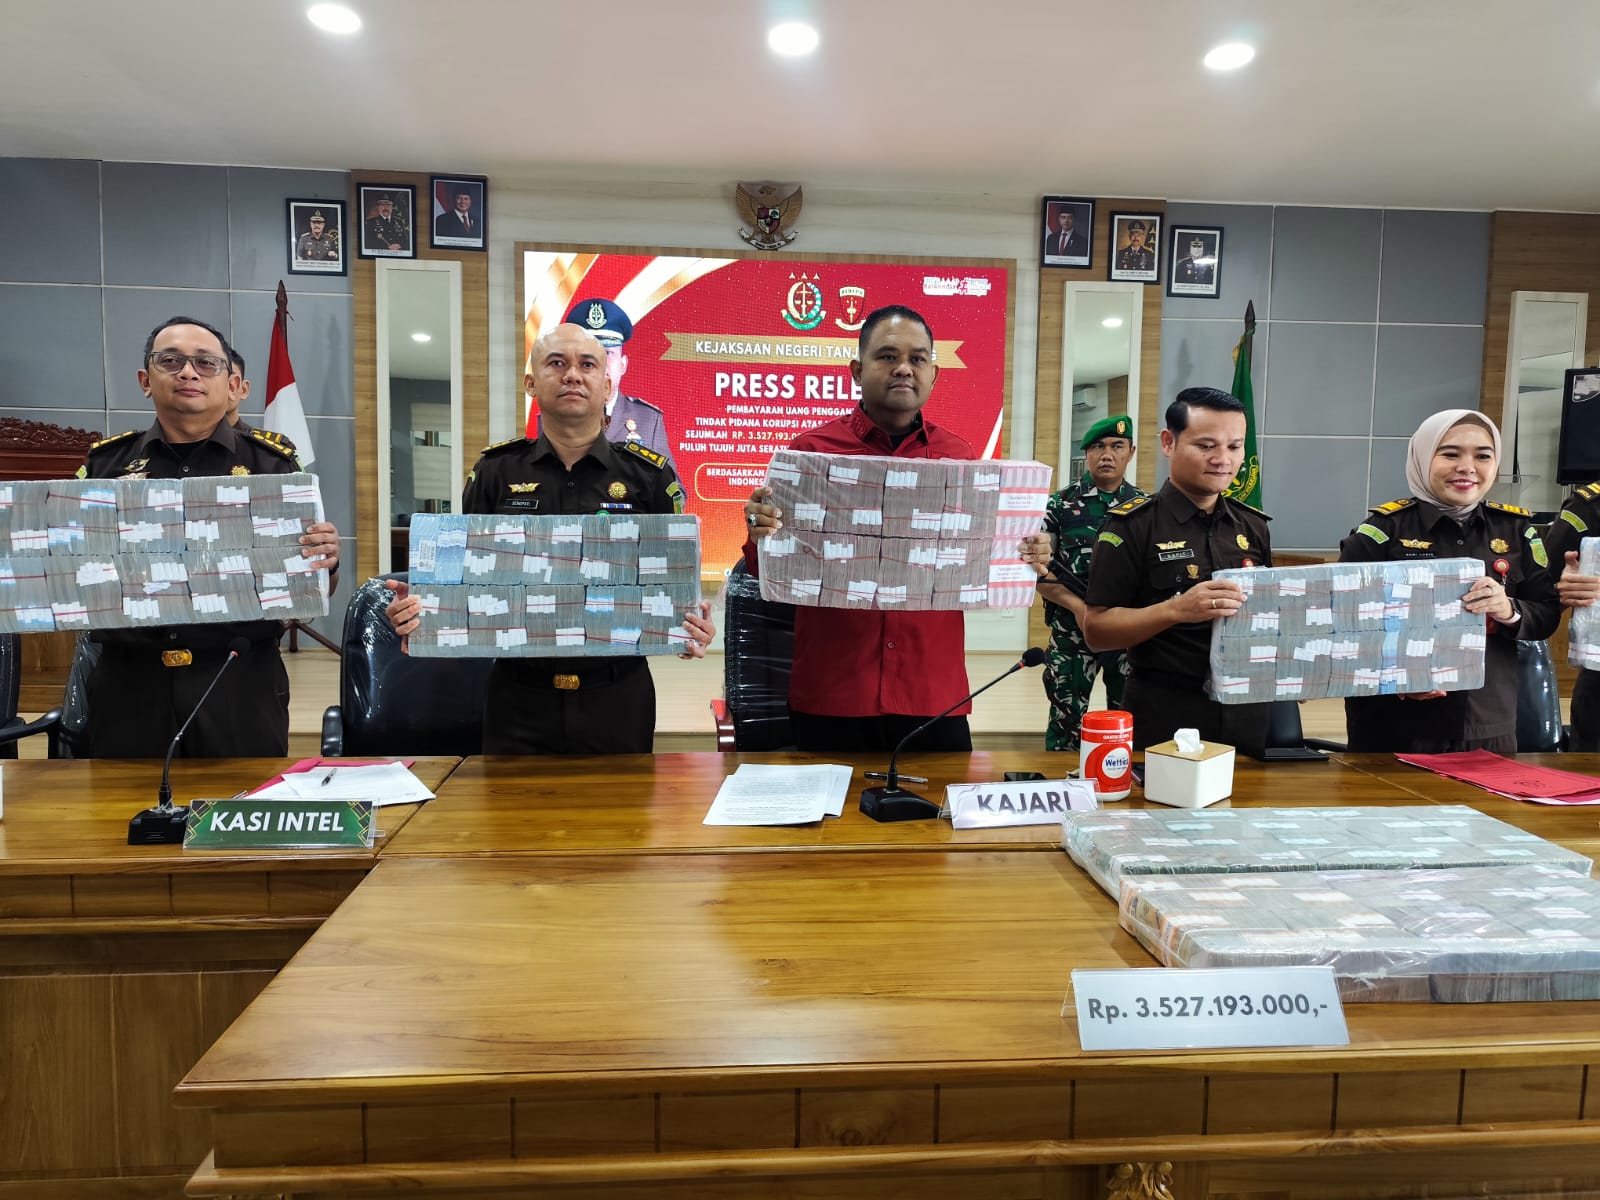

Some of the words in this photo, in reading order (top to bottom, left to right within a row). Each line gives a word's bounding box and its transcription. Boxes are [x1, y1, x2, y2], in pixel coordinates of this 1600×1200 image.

[696, 341, 771, 355] KEJAKSAAN
[776, 344, 822, 357] NEGERI
[826, 345, 860, 359] TANJ
[715, 372, 796, 399] PRESS
[805, 375, 863, 400] RELE
[726, 405, 784, 415] PEMBAYARAN
[786, 406, 809, 416] UANG
[811, 406, 854, 416] PENGGAN
[695, 417, 726, 427] TINDAK
[729, 418, 760, 427] PIDANA
[763, 418, 799, 428] KORUPSI
[685, 430, 728, 439] SEJUMLAH
[732, 431, 746, 440] RP.
[748, 431, 801, 441] 3.527.193.0
[679, 442, 707, 452] PULUH
[709, 443, 734, 452] TUJUH
[736, 443, 757, 453] JUTA
[706, 468, 765, 477] BERDASARKAN
[728, 477, 764, 486] INDONES
[976, 790, 1072, 815] KAJARI
[210, 811, 271, 832] KASI
[277, 811, 344, 832] INTEL
[1088, 997, 1128, 1024] Rp.
[1136, 994, 1328, 1018] 3.527.193.000,-
